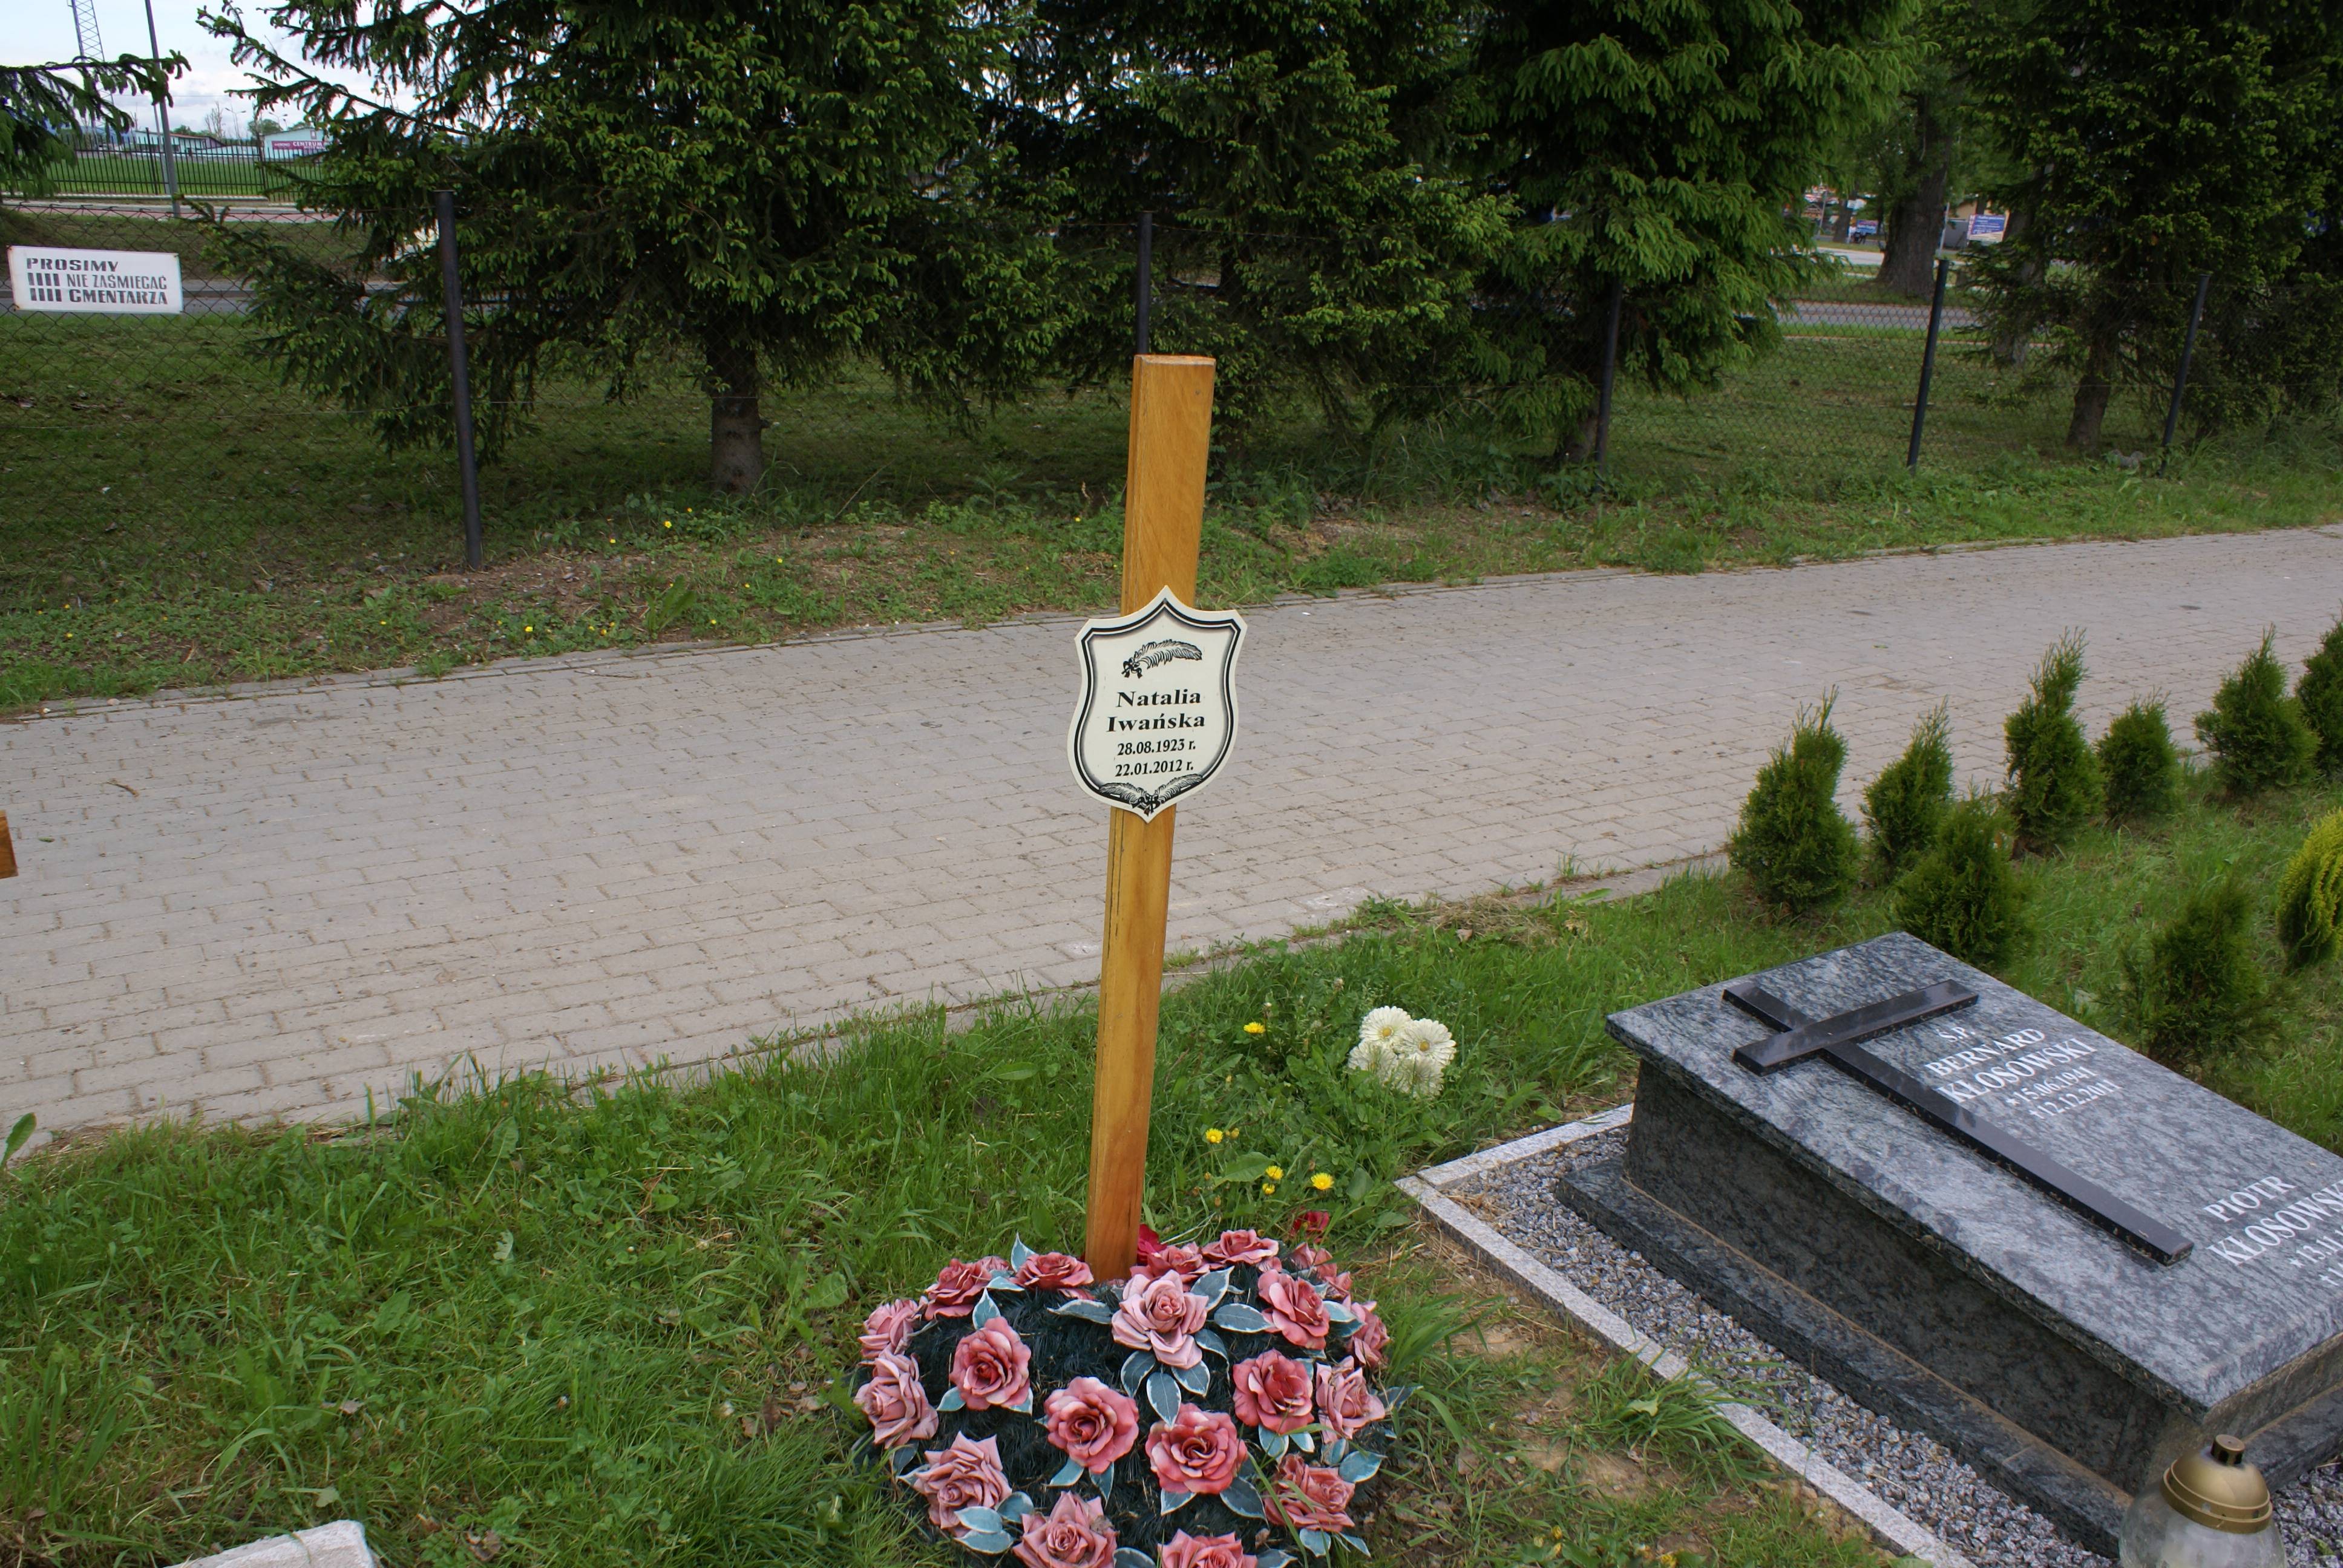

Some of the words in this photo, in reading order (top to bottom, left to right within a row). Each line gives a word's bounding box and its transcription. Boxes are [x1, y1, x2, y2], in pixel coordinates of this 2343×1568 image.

[27, 258, 118, 272] PROSIMY
[67, 273, 88, 287] NIE
[1116, 688, 1201, 708] Natalia
[1106, 713, 1205, 732] Iwańska
[1117, 739, 1184, 756] 28.08.1923
[1188, 740, 1196, 750] r.
[1115, 759, 1182, 777] 22.01.2012
[1187, 761, 1194, 771] r.
[1924, 1028, 2046, 1076] BERNARD
[2203, 1176, 2297, 1223] PIOTR
[2206, 1179, 2343, 1266] KŁOSOWSK
